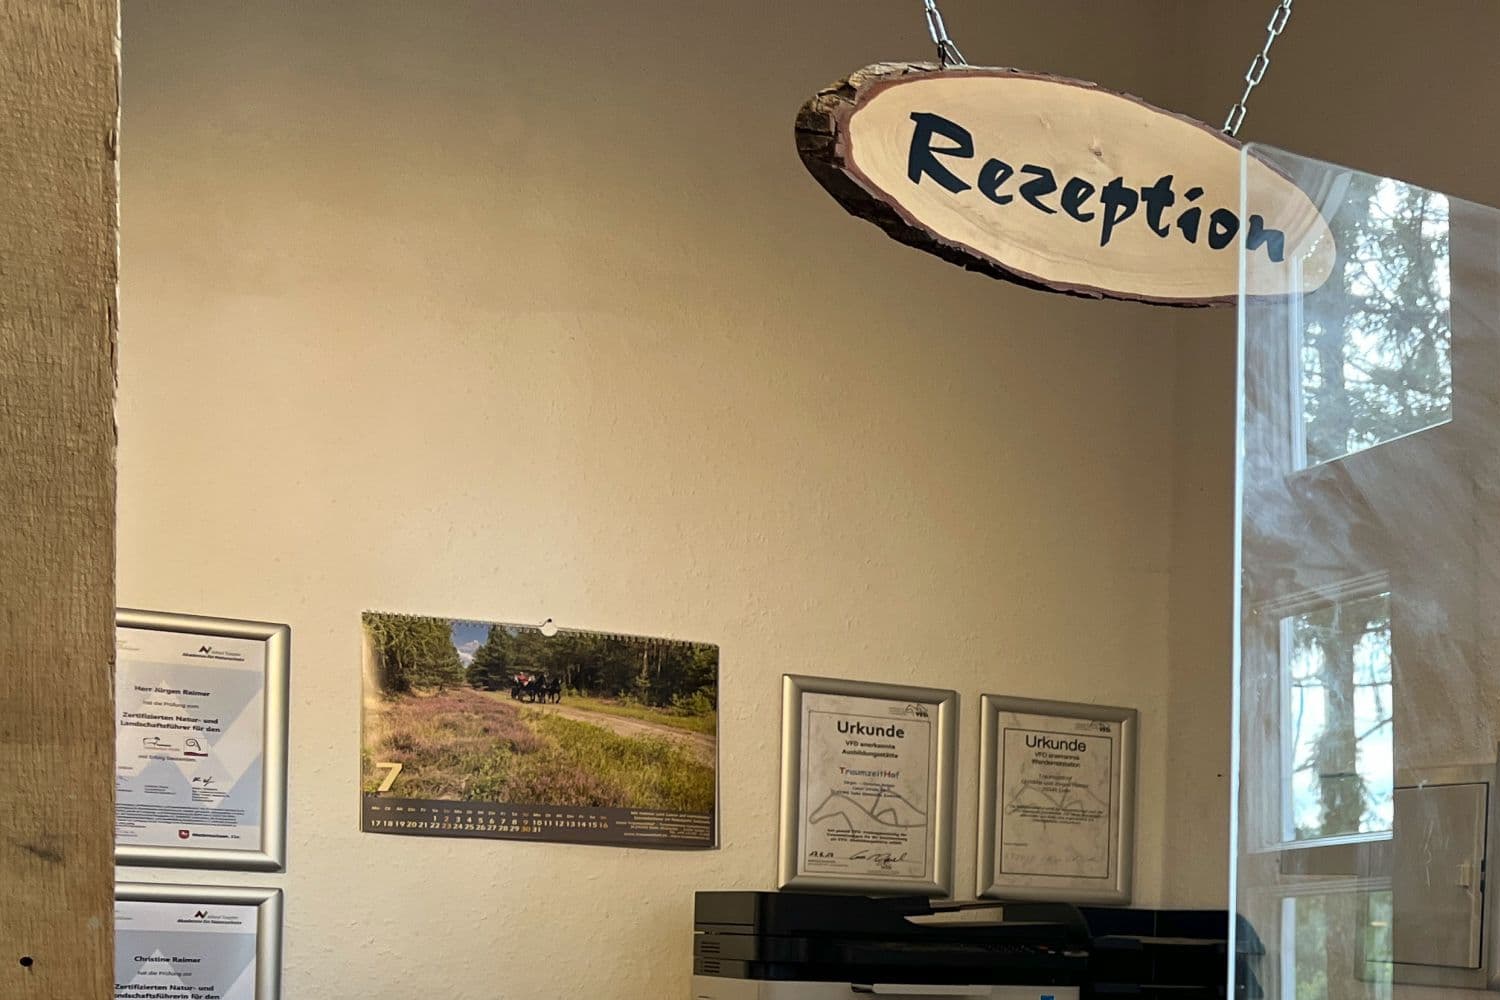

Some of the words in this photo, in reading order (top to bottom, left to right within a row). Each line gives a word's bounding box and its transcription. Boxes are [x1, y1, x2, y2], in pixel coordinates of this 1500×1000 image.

[907, 112, 1285, 262] Rezeption
[837, 720, 905, 739] Urkunde
[1025, 734, 1087, 753] Urkunde
[375, 763, 402, 792] 7
